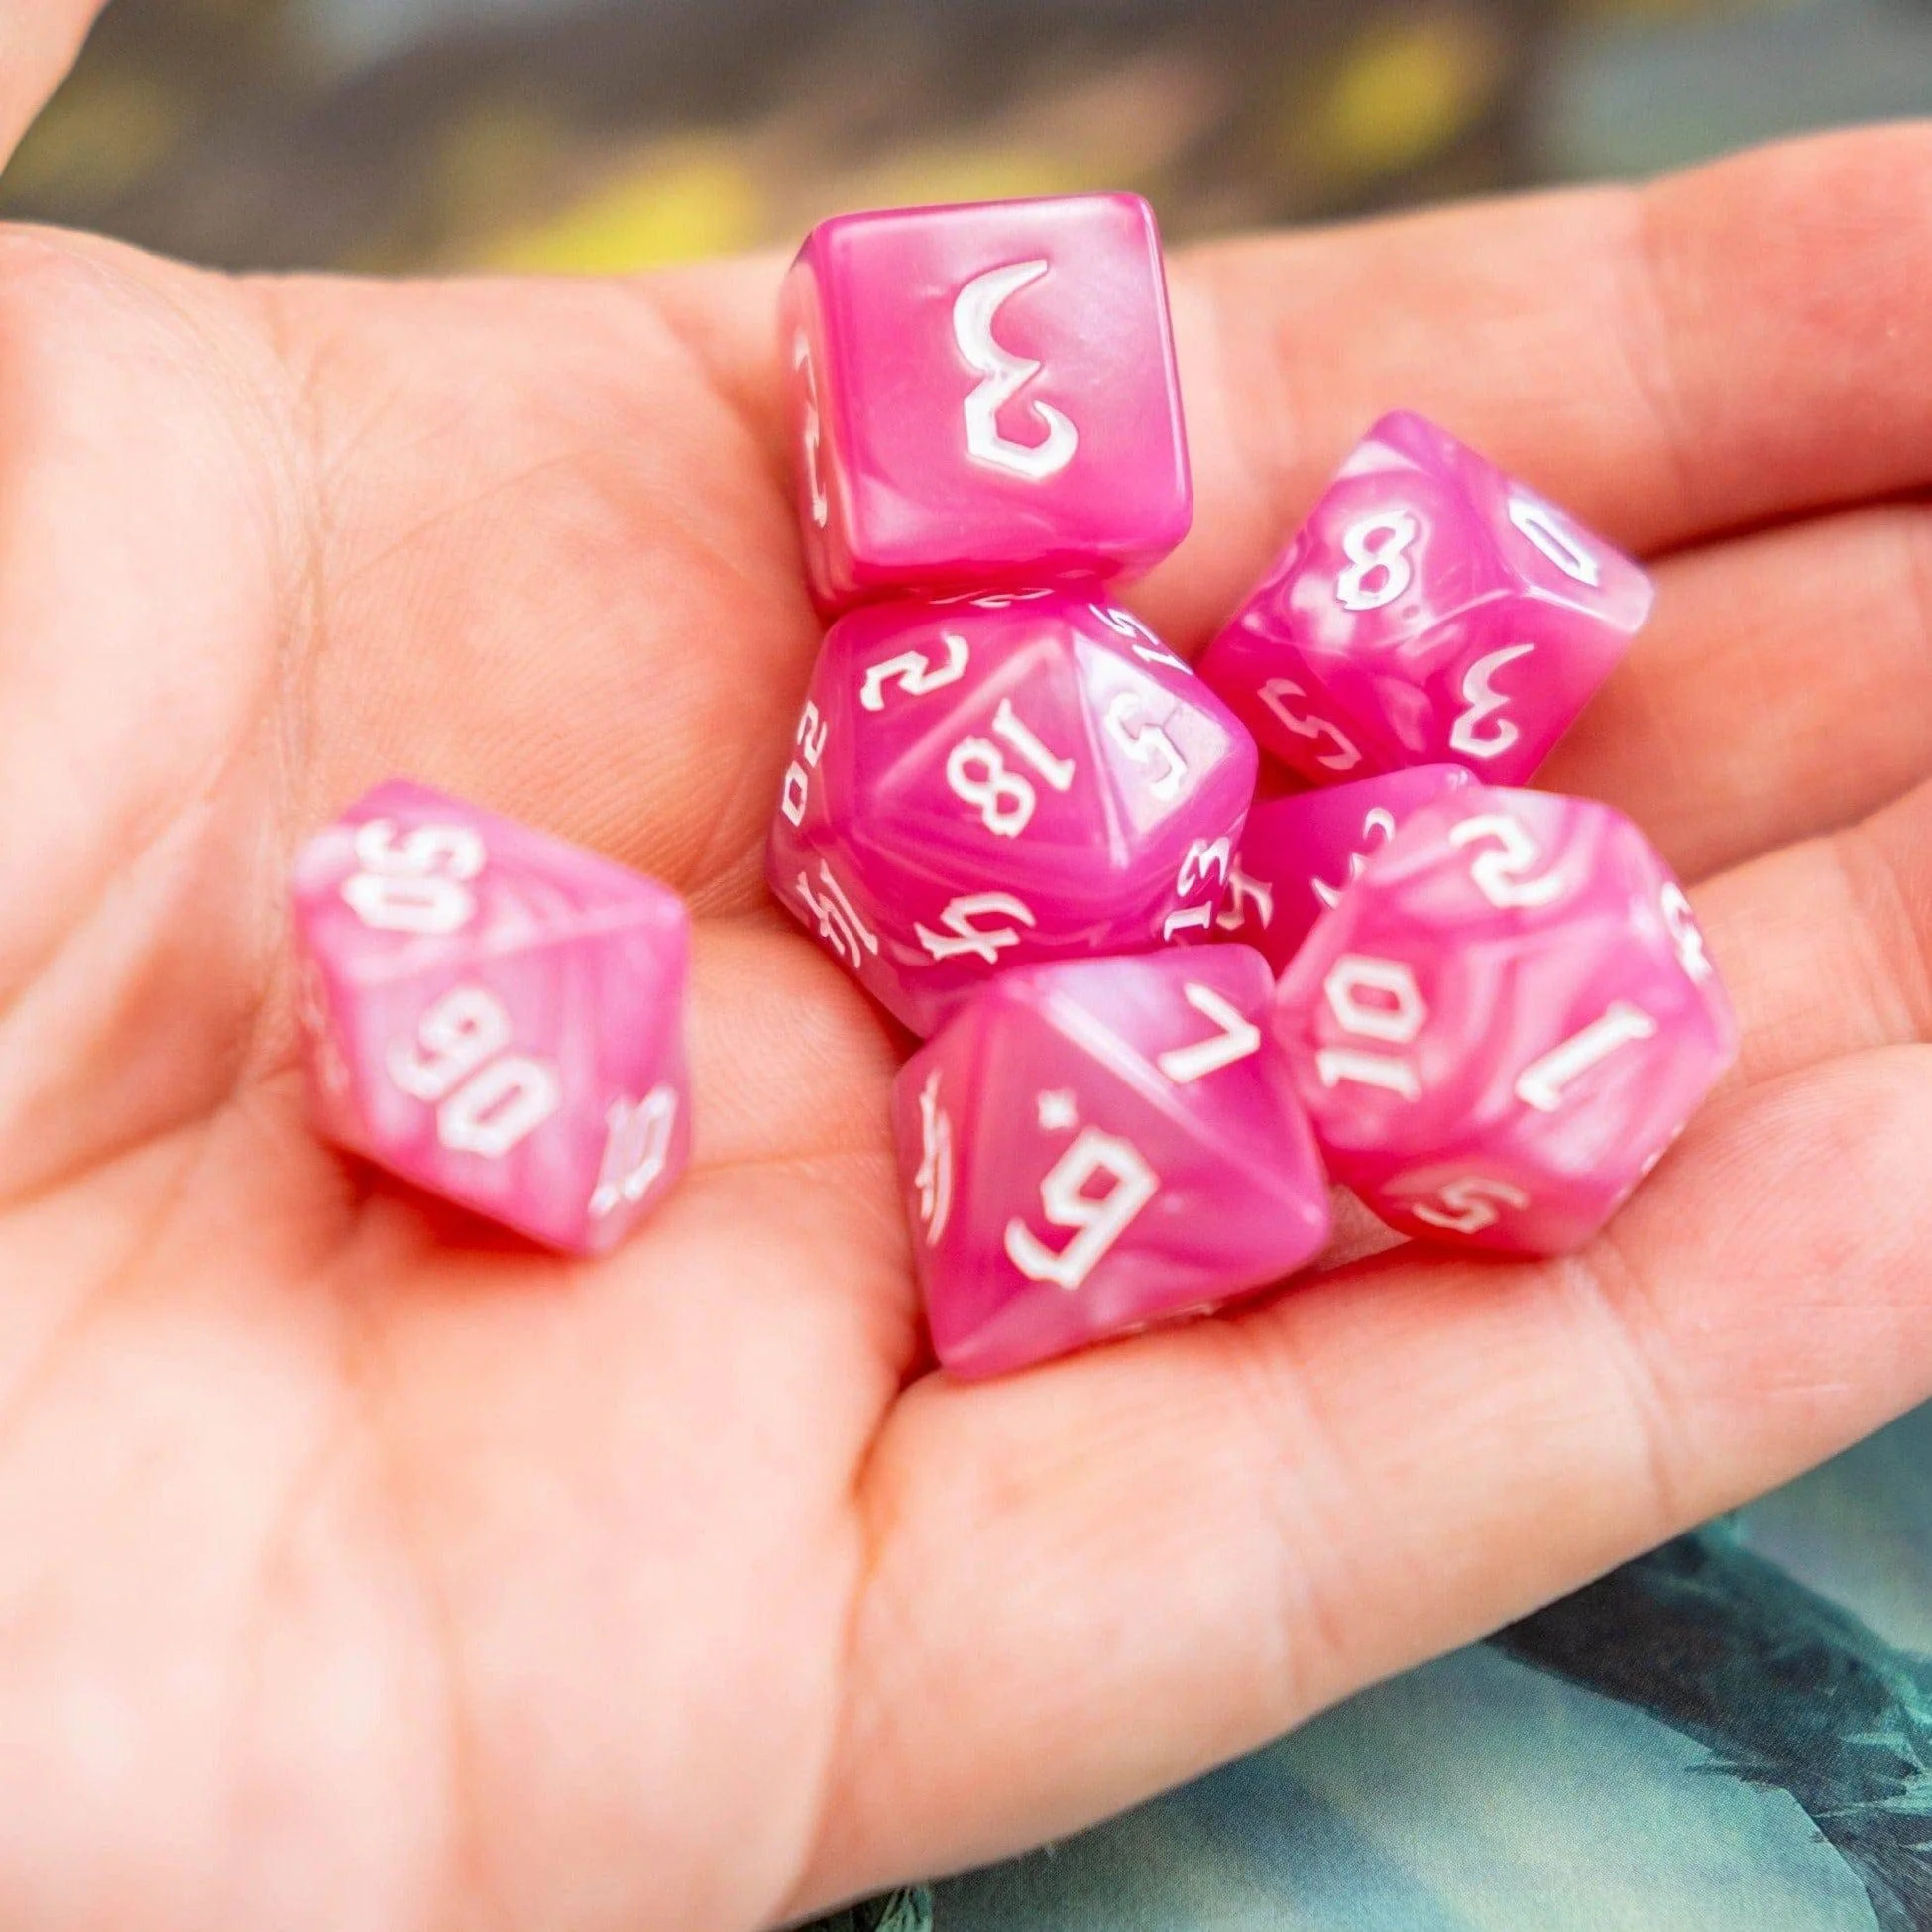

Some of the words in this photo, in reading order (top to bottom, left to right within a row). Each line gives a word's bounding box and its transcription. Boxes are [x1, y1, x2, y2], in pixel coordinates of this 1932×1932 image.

[953, 259, 1080, 479] 3
[1336, 509, 1416, 611] 8
[859, 630, 969, 711] 2
[1449, 643, 1535, 758] 3
[782, 700, 827, 827] 20
[946, 698, 1076, 837] 18
[1103, 692, 1189, 800] 5
[341, 818, 487, 935] 50
[1163, 836, 1230, 941] 13
[1448, 814, 1566, 908] 2
[914, 892, 1036, 965] 4
[385, 984, 560, 1158] 90
[1158, 981, 1261, 1083] 7
[1316, 954, 1427, 1102] 10
[1515, 999, 1657, 1112] 1
